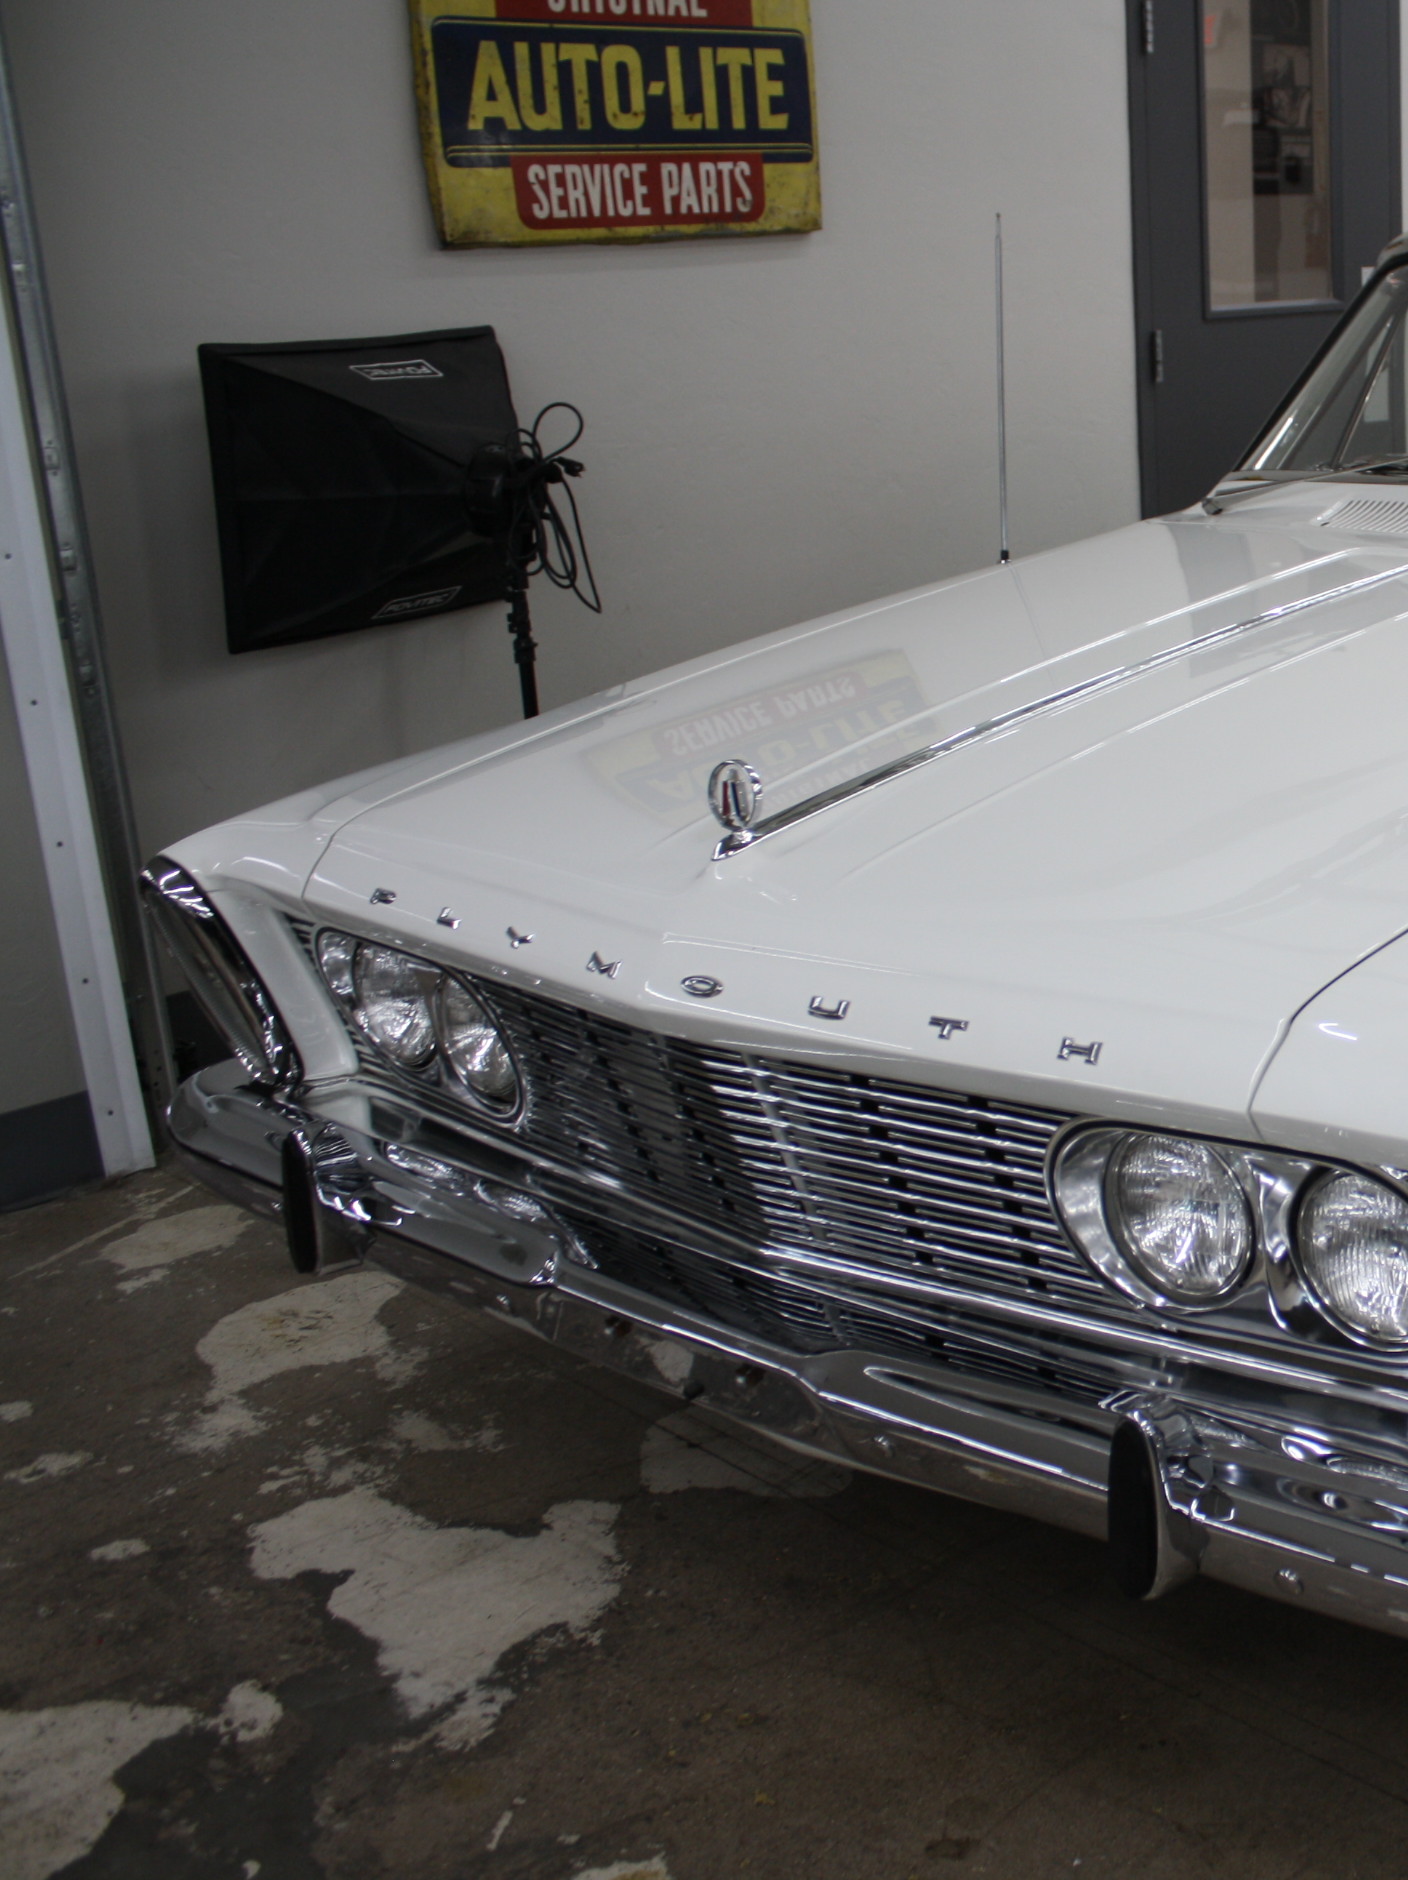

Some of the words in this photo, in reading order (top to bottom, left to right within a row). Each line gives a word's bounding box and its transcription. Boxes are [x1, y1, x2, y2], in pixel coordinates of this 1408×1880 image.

[467, 40, 789, 131] AUTO-LITE
[527, 163, 650, 219] SERVICE
[661, 161, 752, 216] PARTS
[369, 887, 1103, 1066] PLYMOUTH
